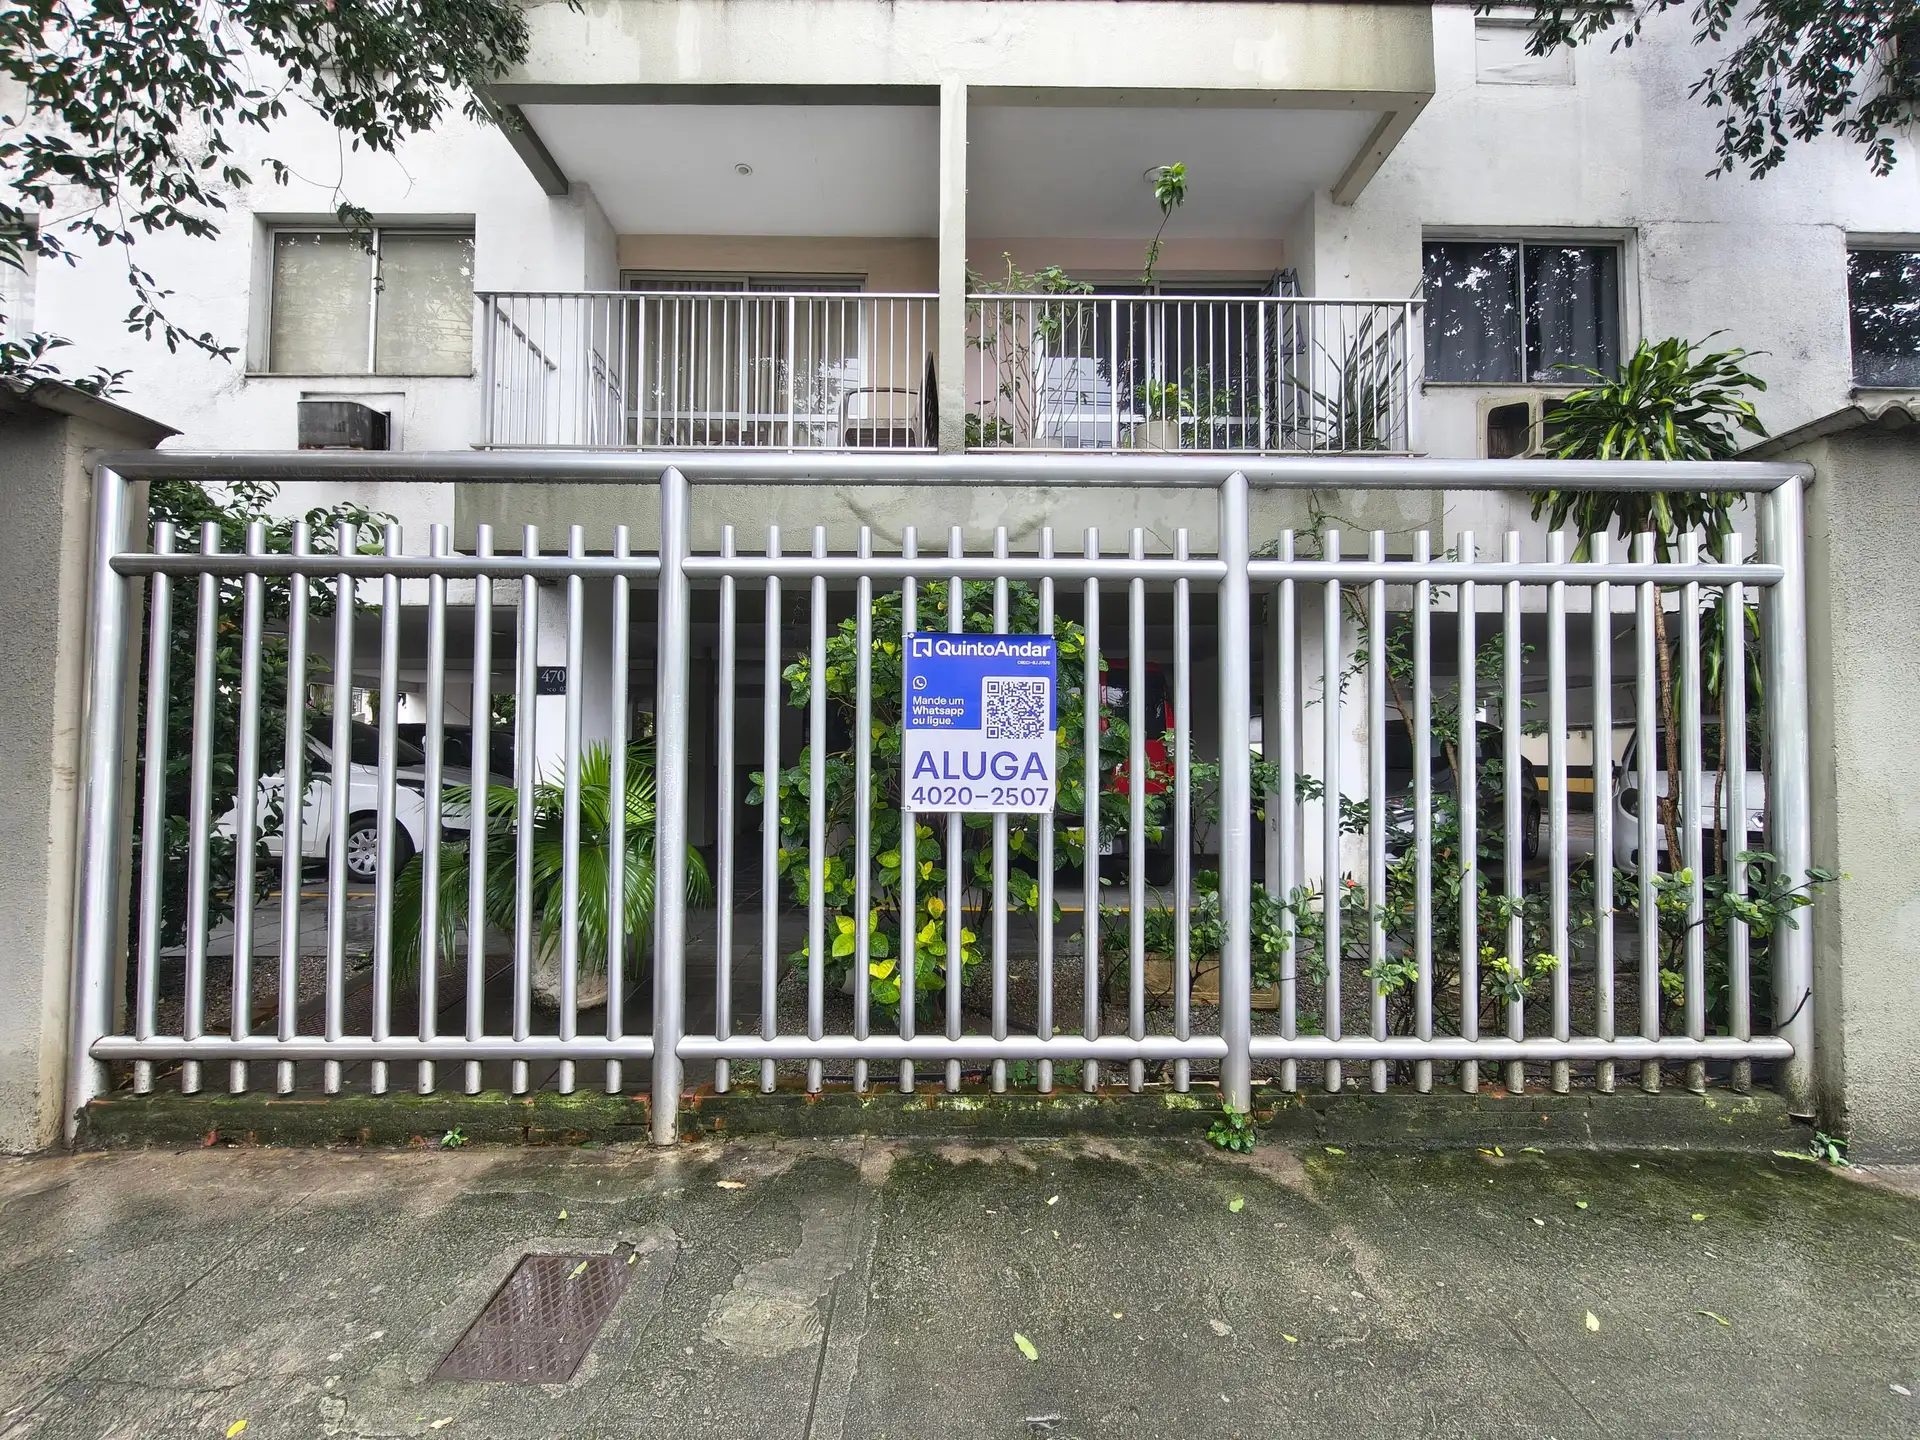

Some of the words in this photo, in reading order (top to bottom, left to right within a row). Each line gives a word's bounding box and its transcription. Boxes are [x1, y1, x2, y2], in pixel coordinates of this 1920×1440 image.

[935, 640, 1050, 657] QuintoAndar
[541, 669, 565, 683] 470
[912, 695, 947, 705] Mande
[912, 705, 964, 717] Whatsapp
[927, 715, 954, 727] ligue.
[912, 750, 1048, 780] ALUGA
[911, 786, 1049, 806] 4020-2507
